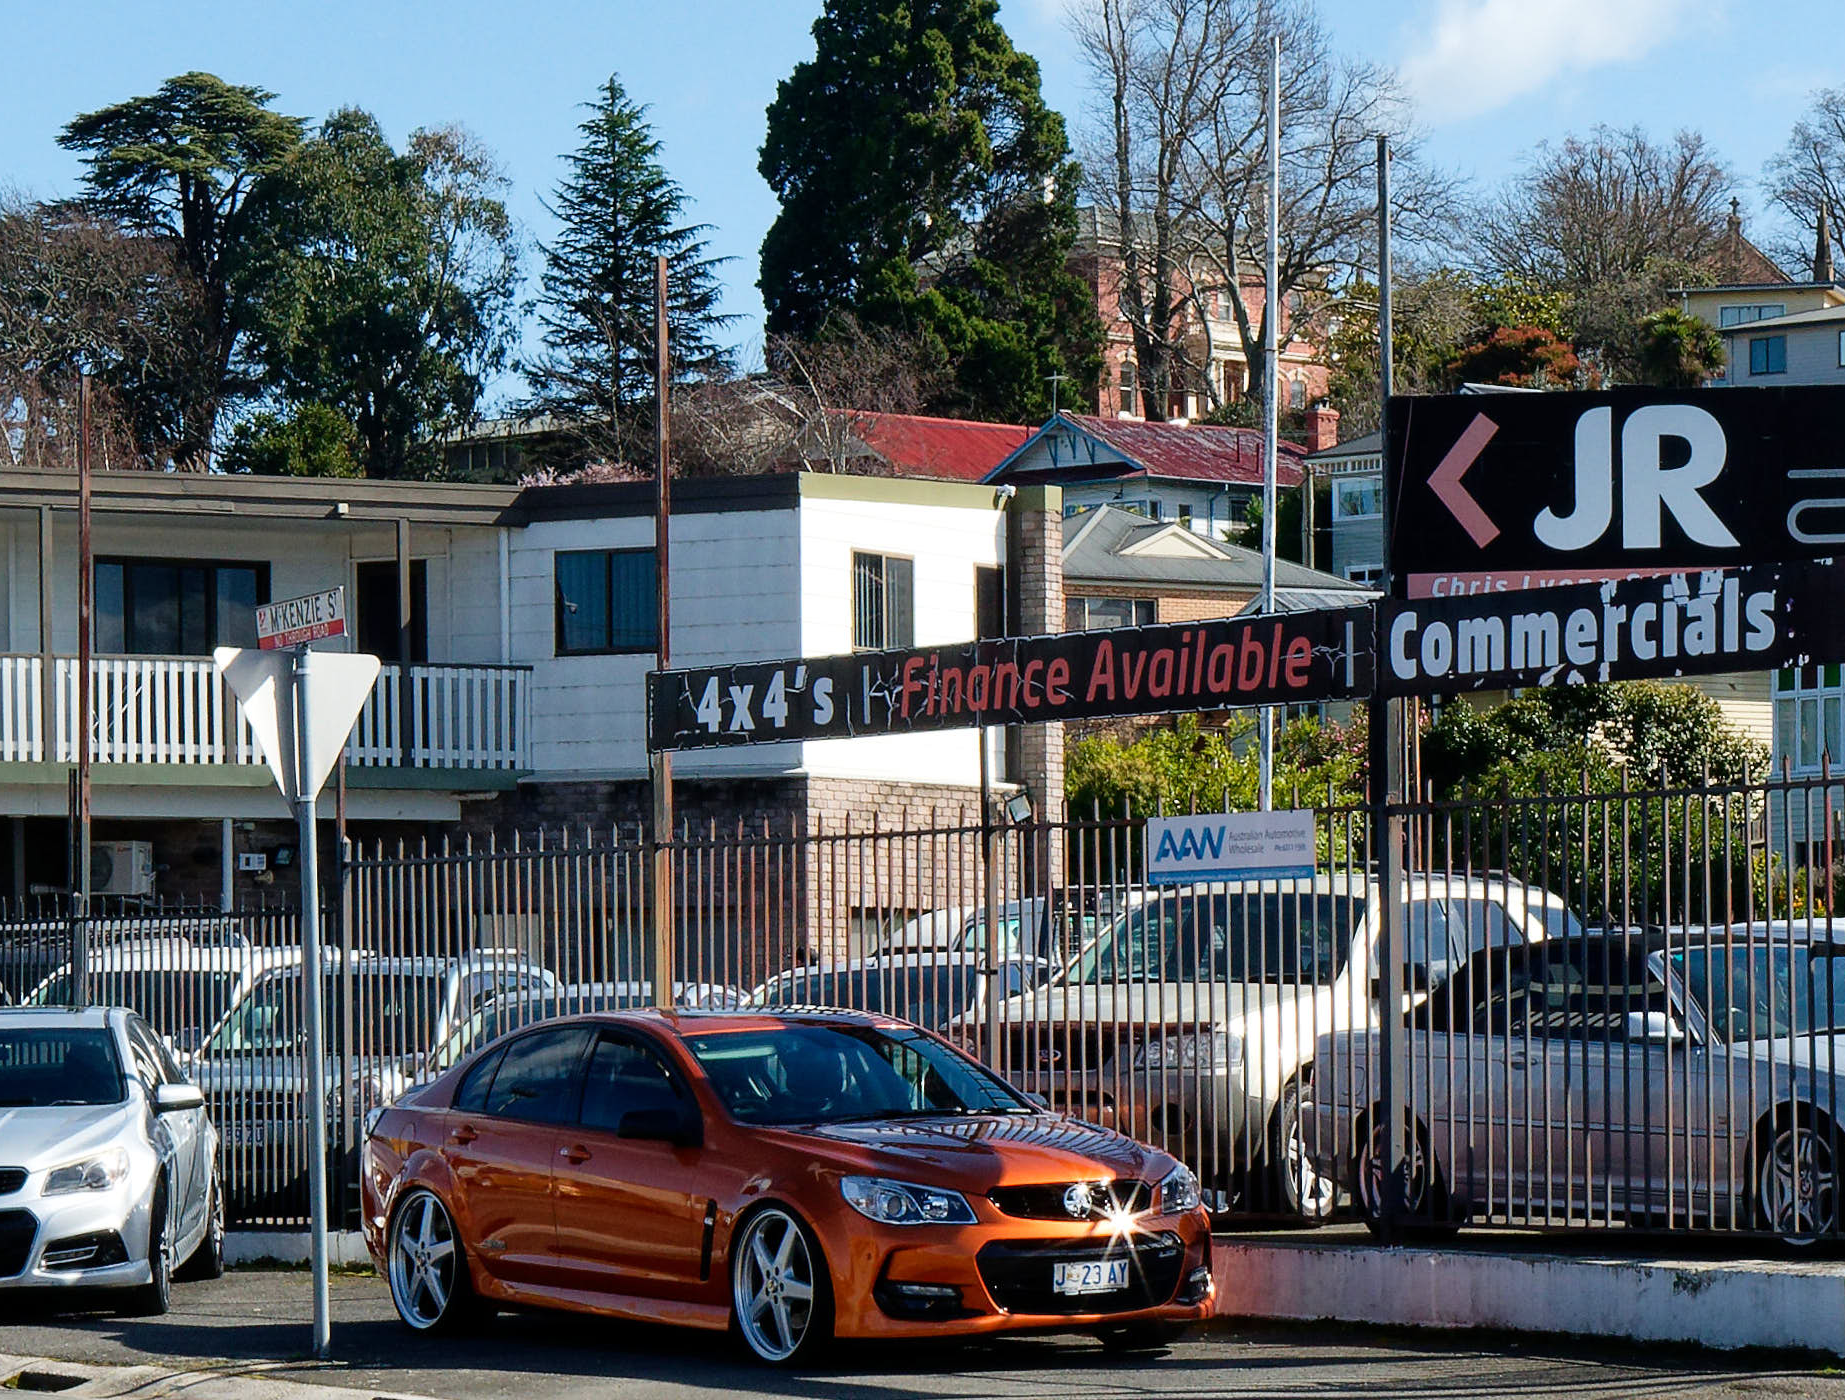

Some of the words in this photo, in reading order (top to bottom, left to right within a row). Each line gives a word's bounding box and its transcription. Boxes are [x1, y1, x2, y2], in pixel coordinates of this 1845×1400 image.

[1533, 403, 1741, 551] JR
[695, 664, 835, 733] 4x4's
[899, 653, 1071, 718] Finance
[1086, 621, 1312, 702] Available
[1390, 577, 1776, 681] Commercials
[1154, 825, 1226, 862] AAW
[1228, 830, 1263, 843] Australian
[1055, 1264, 1066, 1287] J
[1081, 1264, 1102, 1286] 23
[1108, 1261, 1128, 1284] AY
